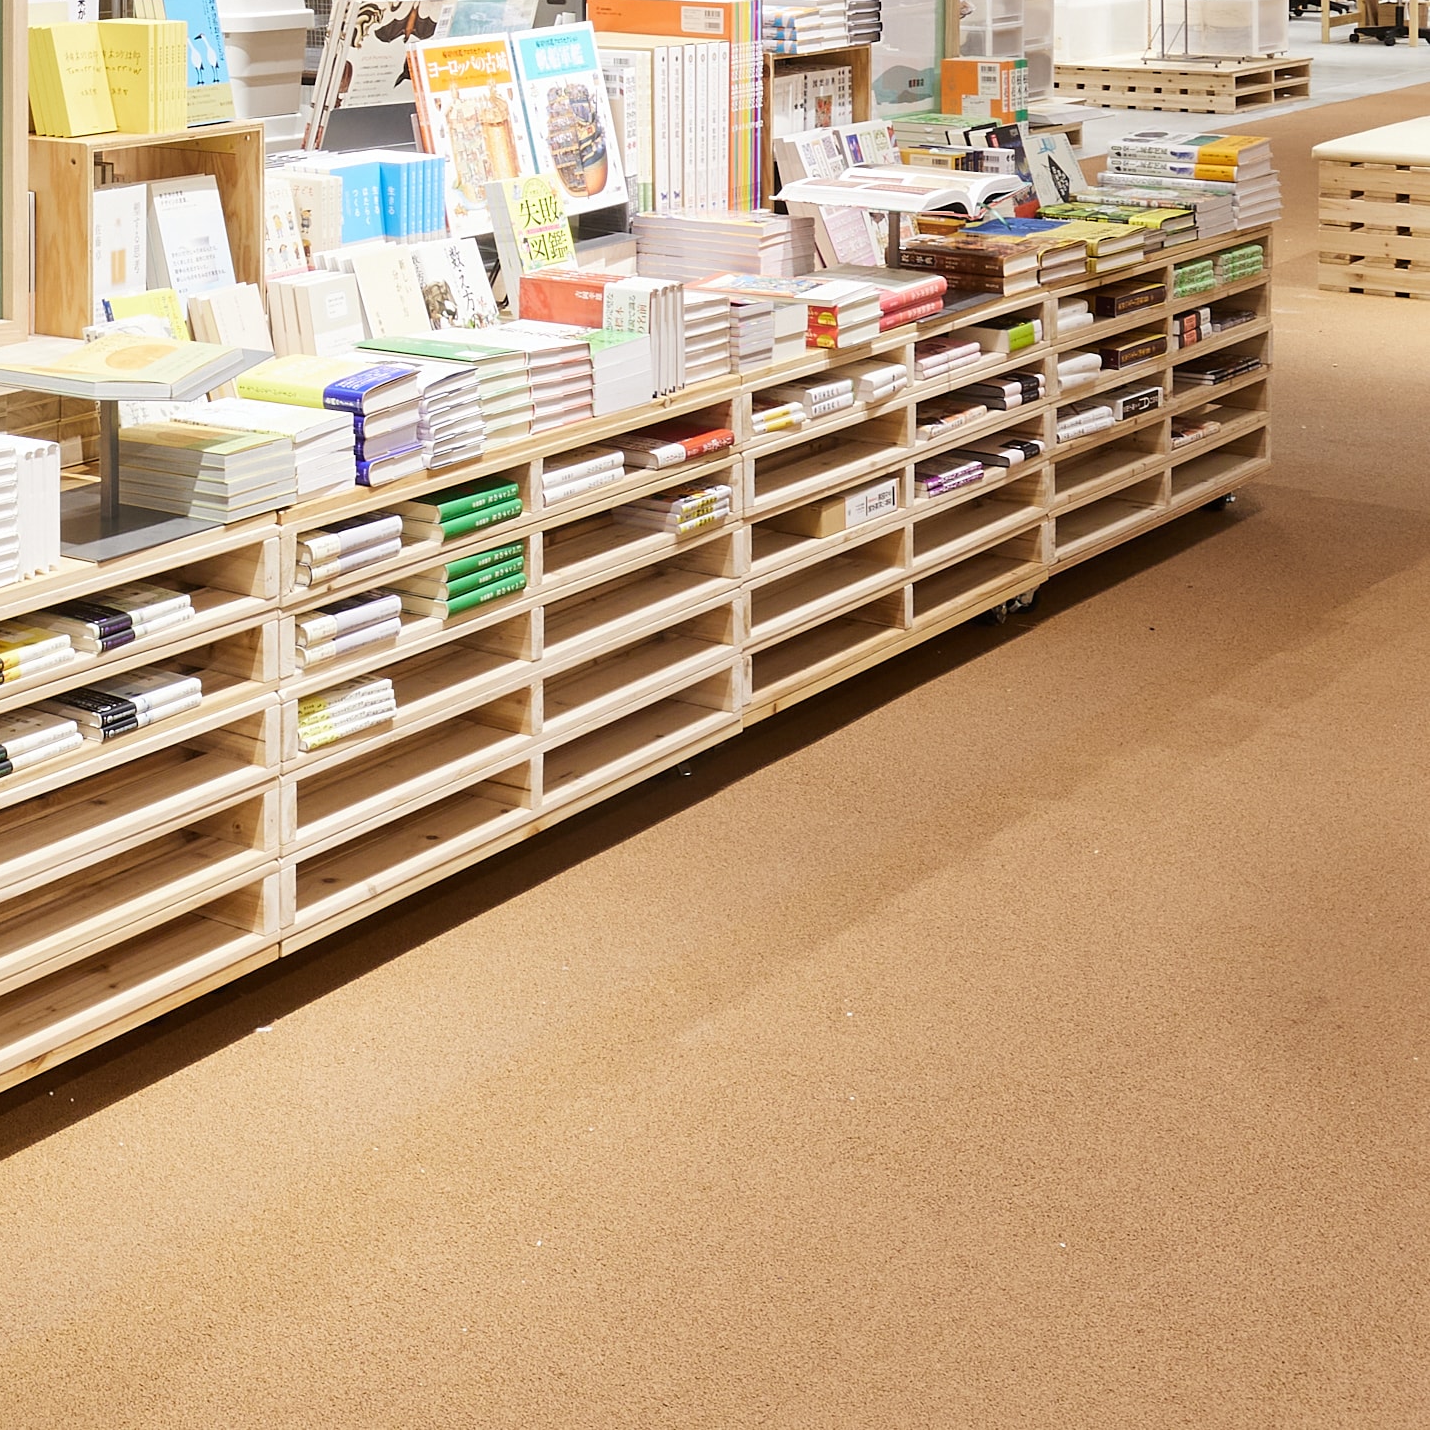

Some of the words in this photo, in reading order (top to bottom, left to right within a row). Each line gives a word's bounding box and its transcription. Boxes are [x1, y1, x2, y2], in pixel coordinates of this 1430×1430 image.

[427, 51, 509, 79] ヨーロッパの古城
[387, 186, 396, 216] 生きる
[519, 195, 559, 229] 失敗
[525, 230, 568, 262] 図鑑
